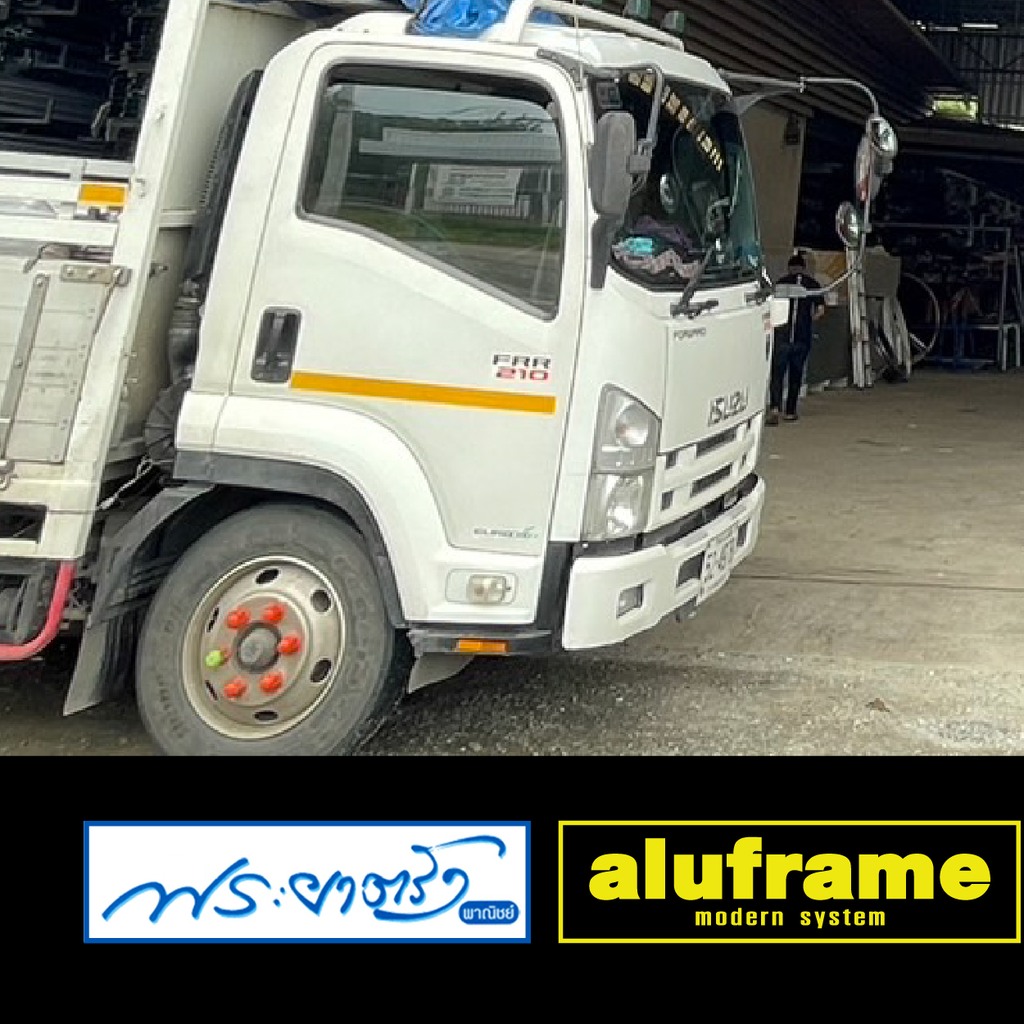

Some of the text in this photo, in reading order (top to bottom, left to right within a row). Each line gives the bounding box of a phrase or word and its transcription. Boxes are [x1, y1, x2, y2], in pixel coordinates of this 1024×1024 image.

[493, 354, 551, 369] FRR
[496, 367, 548, 380] 210
[707, 386, 749, 427] ISUZU
